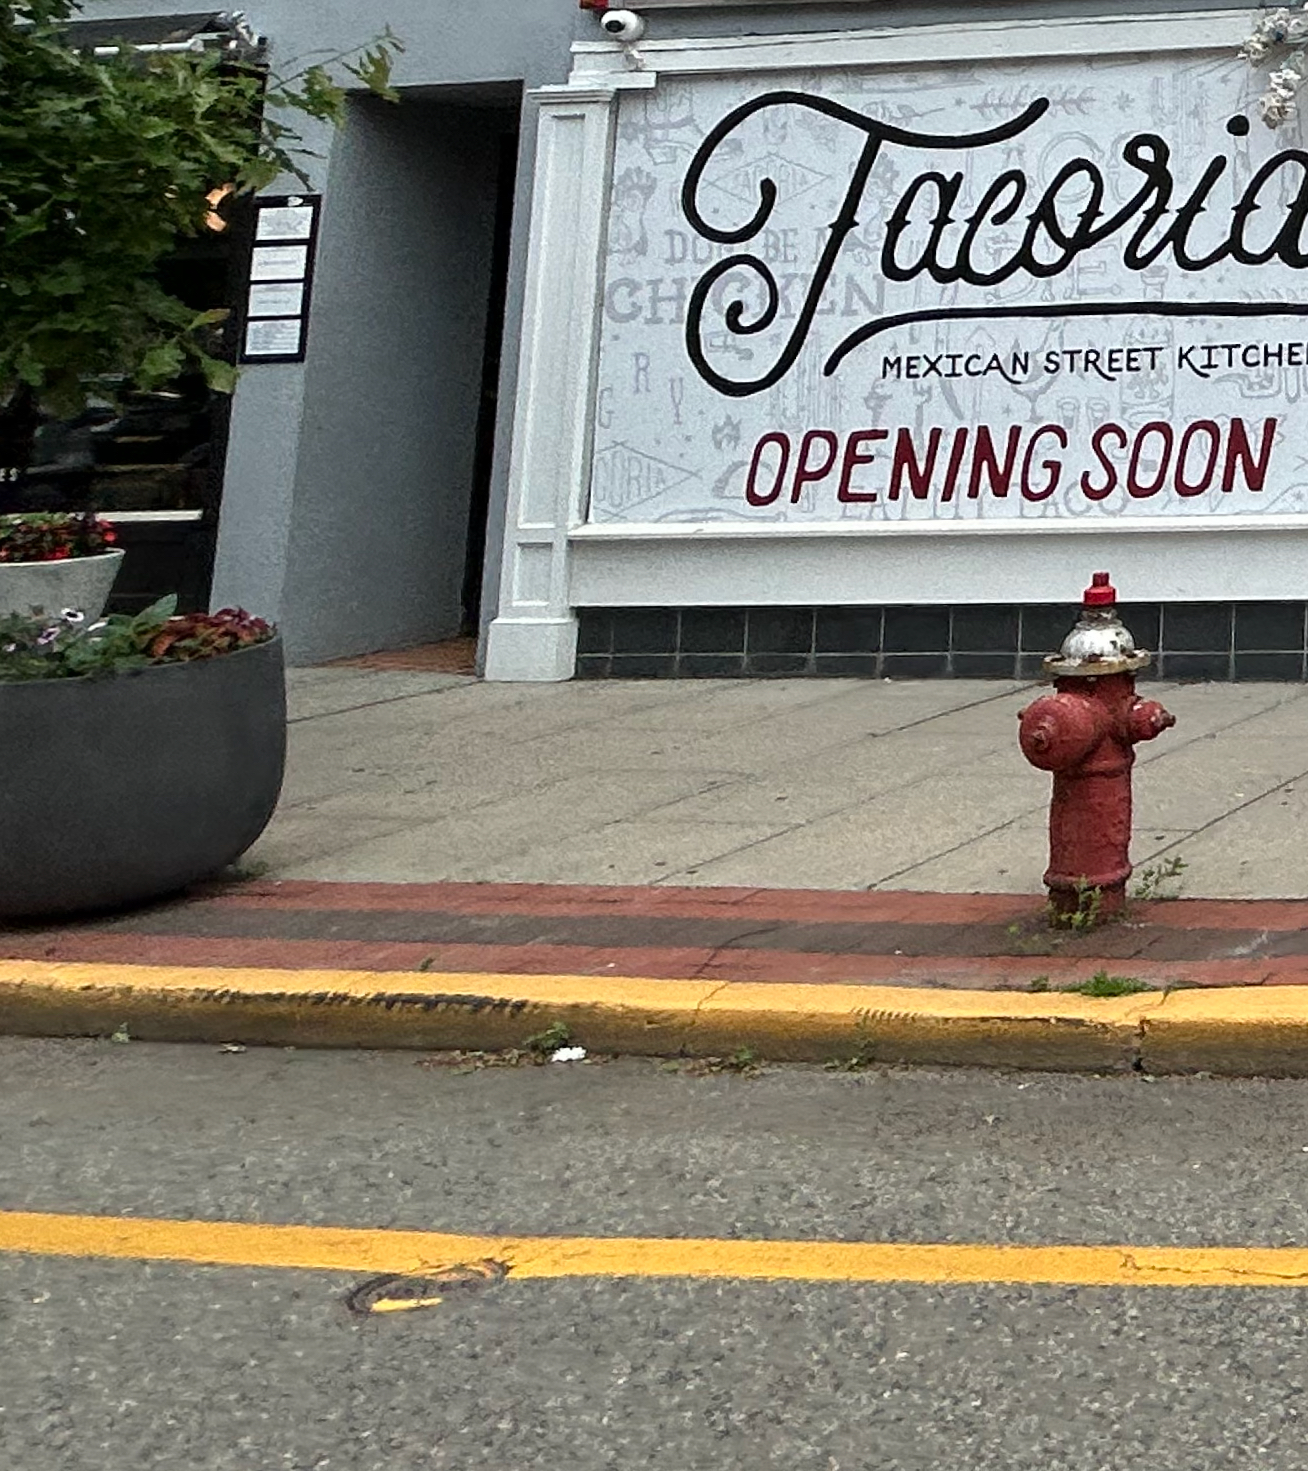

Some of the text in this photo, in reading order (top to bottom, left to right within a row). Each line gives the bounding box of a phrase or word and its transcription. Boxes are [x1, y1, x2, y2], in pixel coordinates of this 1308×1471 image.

[881, 349, 1029, 385] MEXICAN
[1043, 346, 1164, 382] STREET
[744, 422, 1070, 508] OPENING
[1080, 416, 1278, 502] SOON
